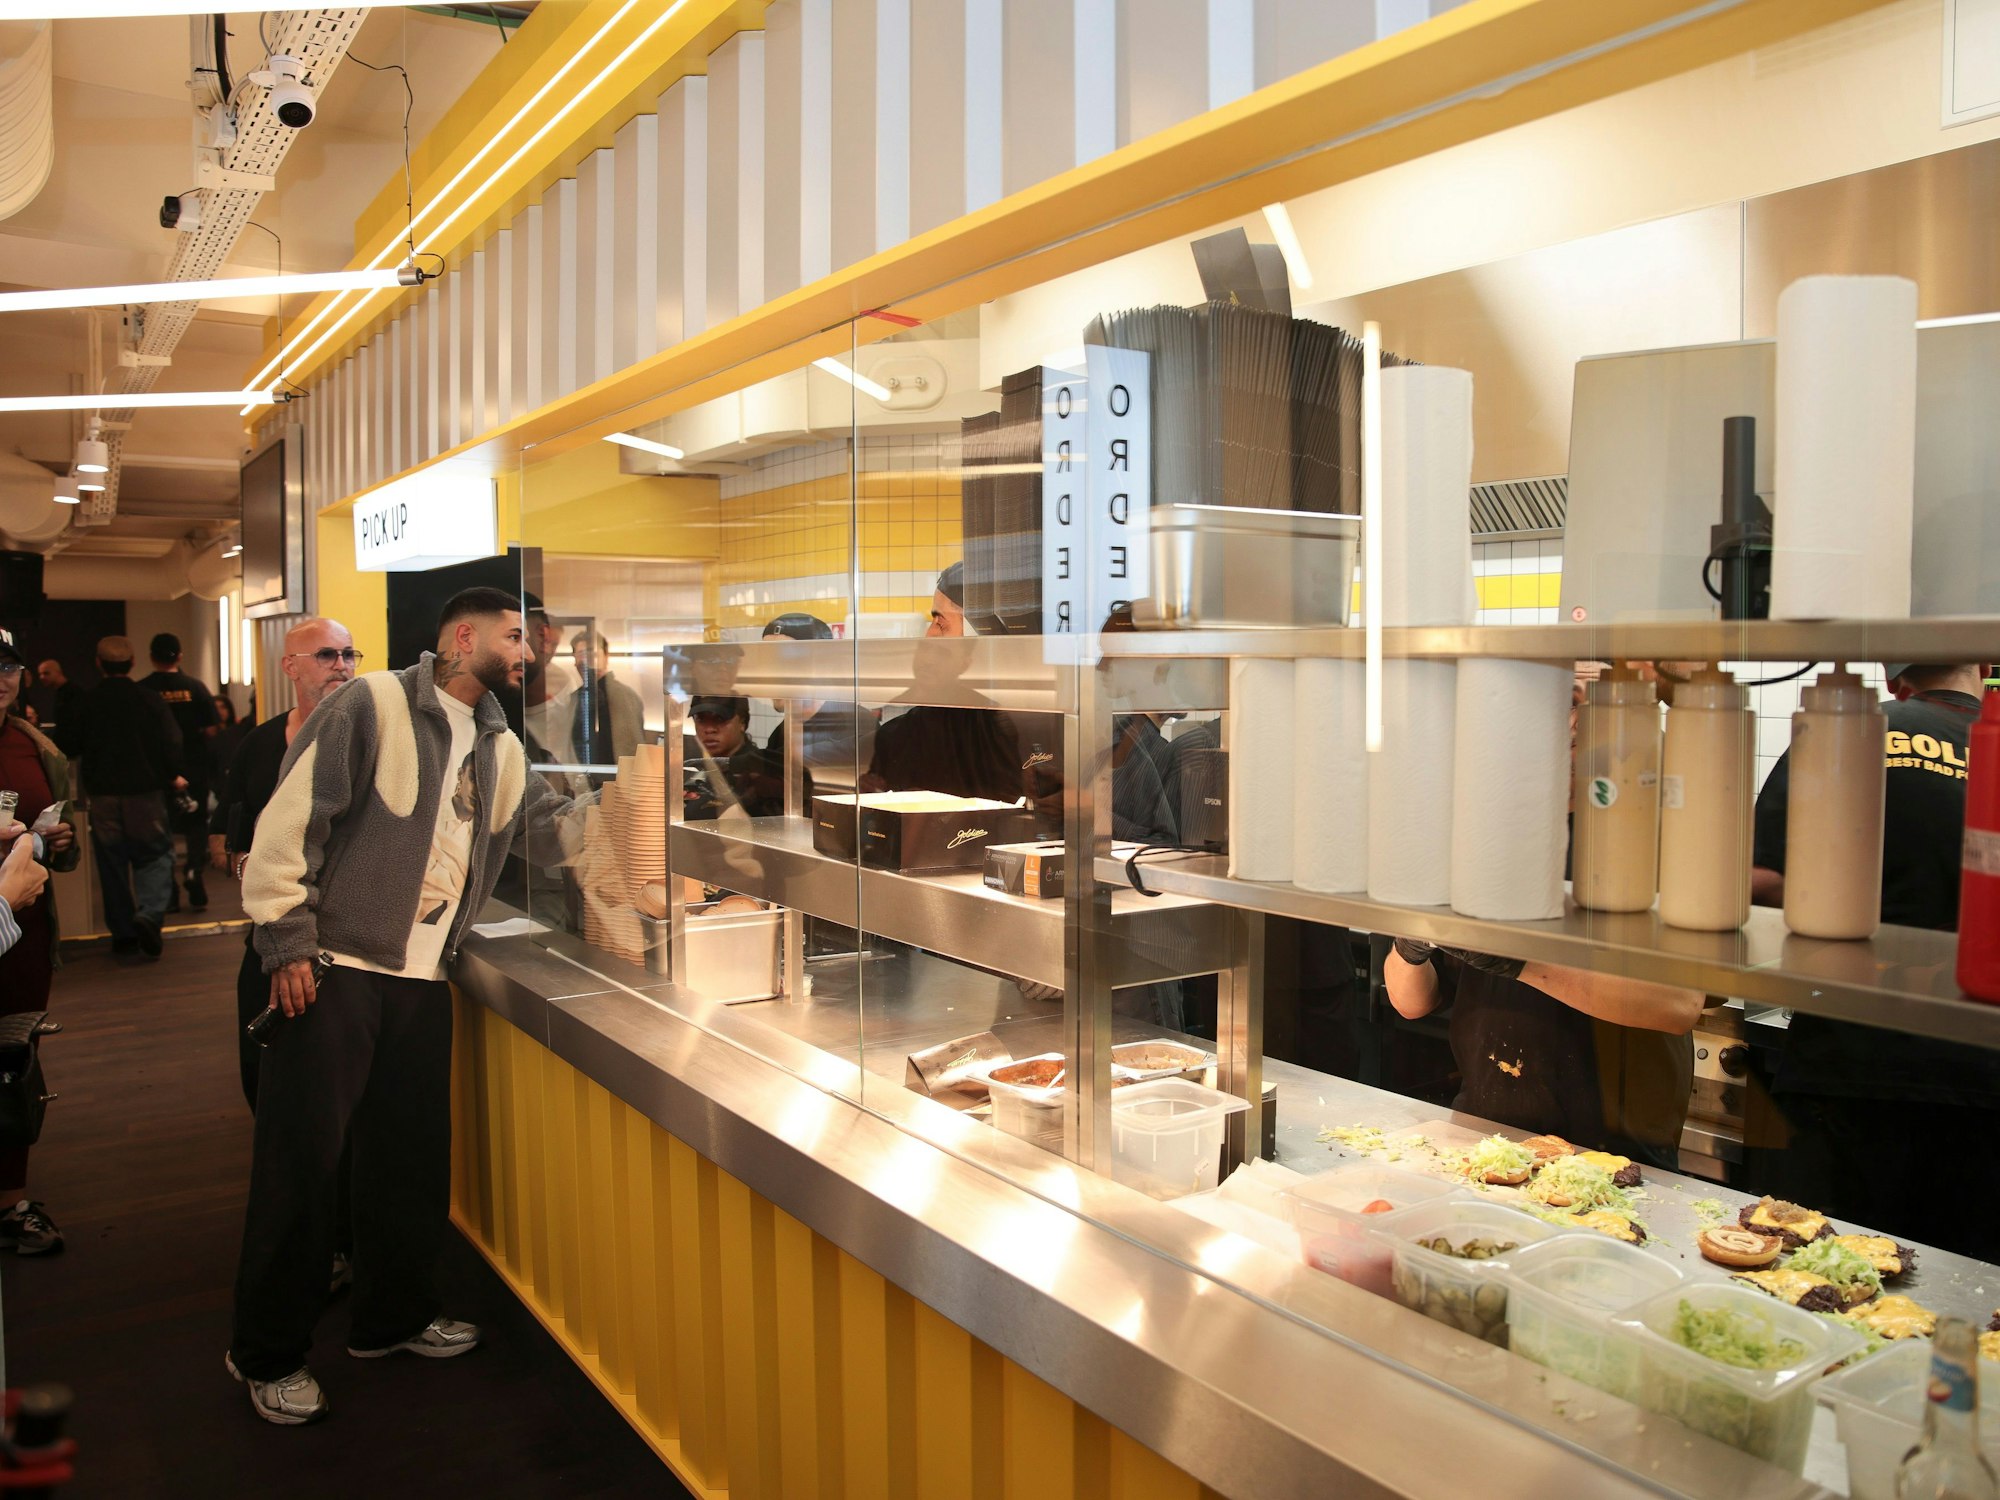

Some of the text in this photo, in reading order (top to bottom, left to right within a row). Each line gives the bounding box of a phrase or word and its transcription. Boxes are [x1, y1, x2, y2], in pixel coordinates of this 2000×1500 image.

[362, 503, 408, 550] PICK UP
[1886, 731, 1970, 768] GOL
[1884, 757, 1922, 768] BEST
[1924, 760, 1954, 777] BAD
[1204, 797, 1222, 806] EPSON
